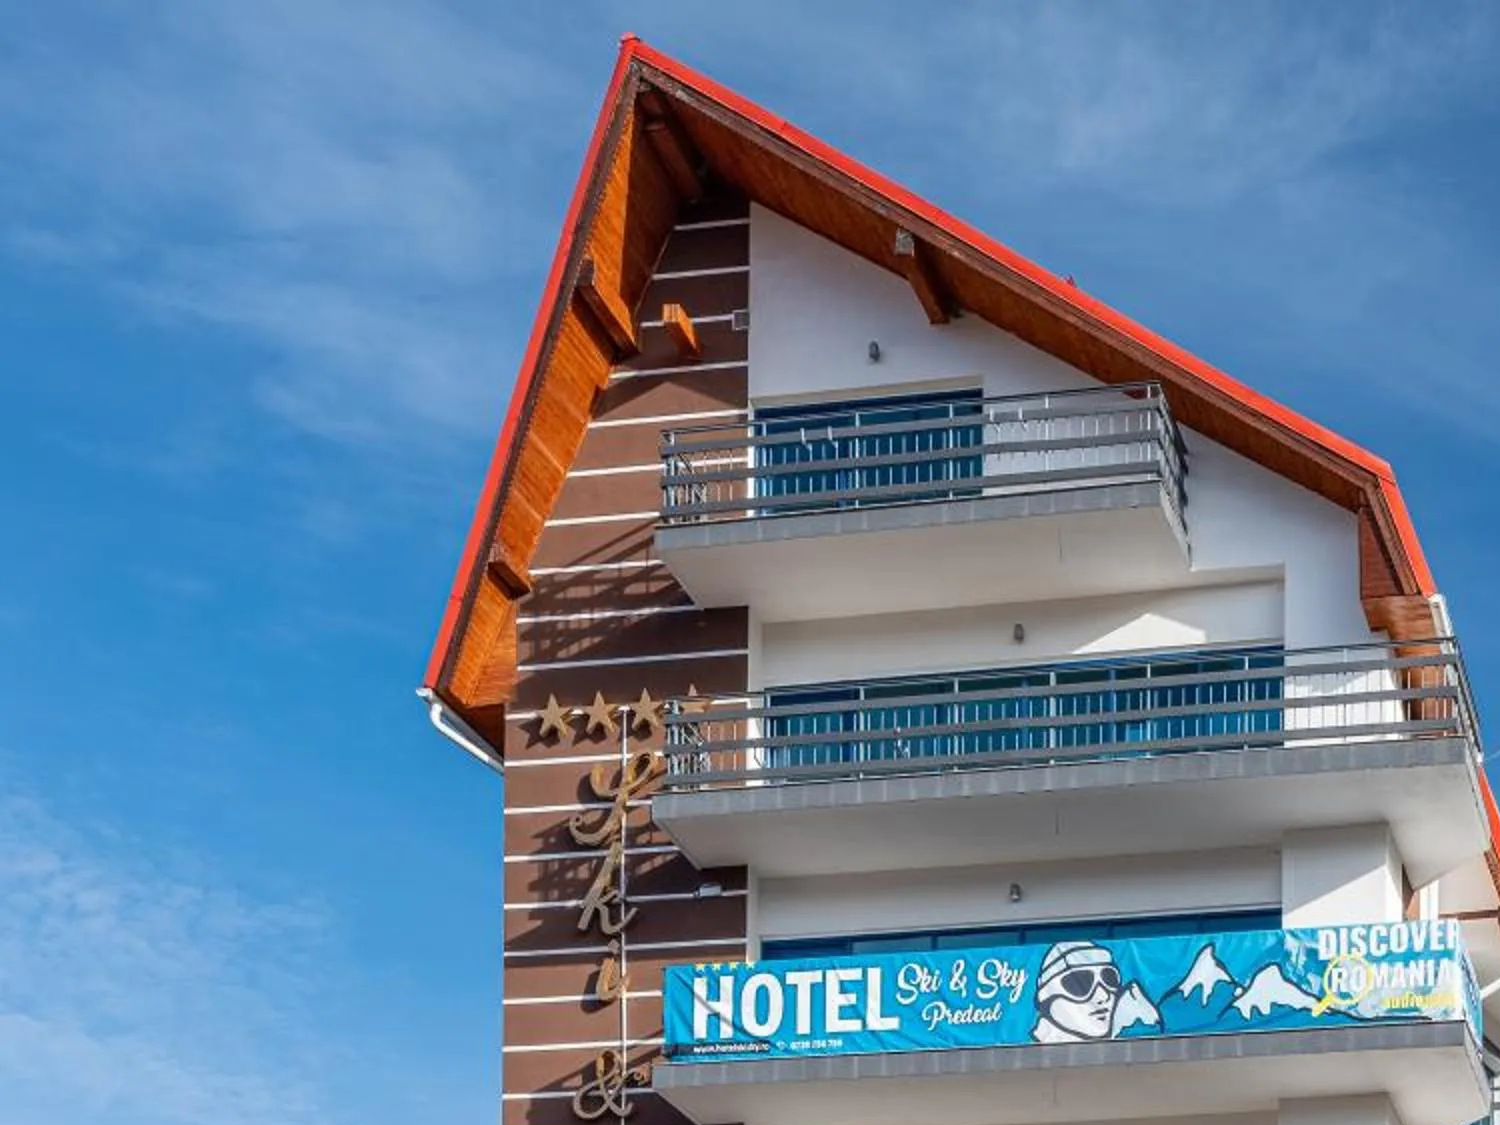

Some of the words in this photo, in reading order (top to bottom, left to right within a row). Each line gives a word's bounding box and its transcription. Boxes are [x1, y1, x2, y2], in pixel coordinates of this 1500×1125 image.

[568, 750, 665, 1000] Ski
[692, 966, 899, 1040] HOTEL
[895, 961, 943, 1005] Ski
[949, 958, 968, 999] &
[975, 958, 1027, 1001] Sky
[1331, 957, 1456, 993] ROMANIA
[921, 1000, 1003, 1032] Predeal
[573, 1049, 651, 1120] &
